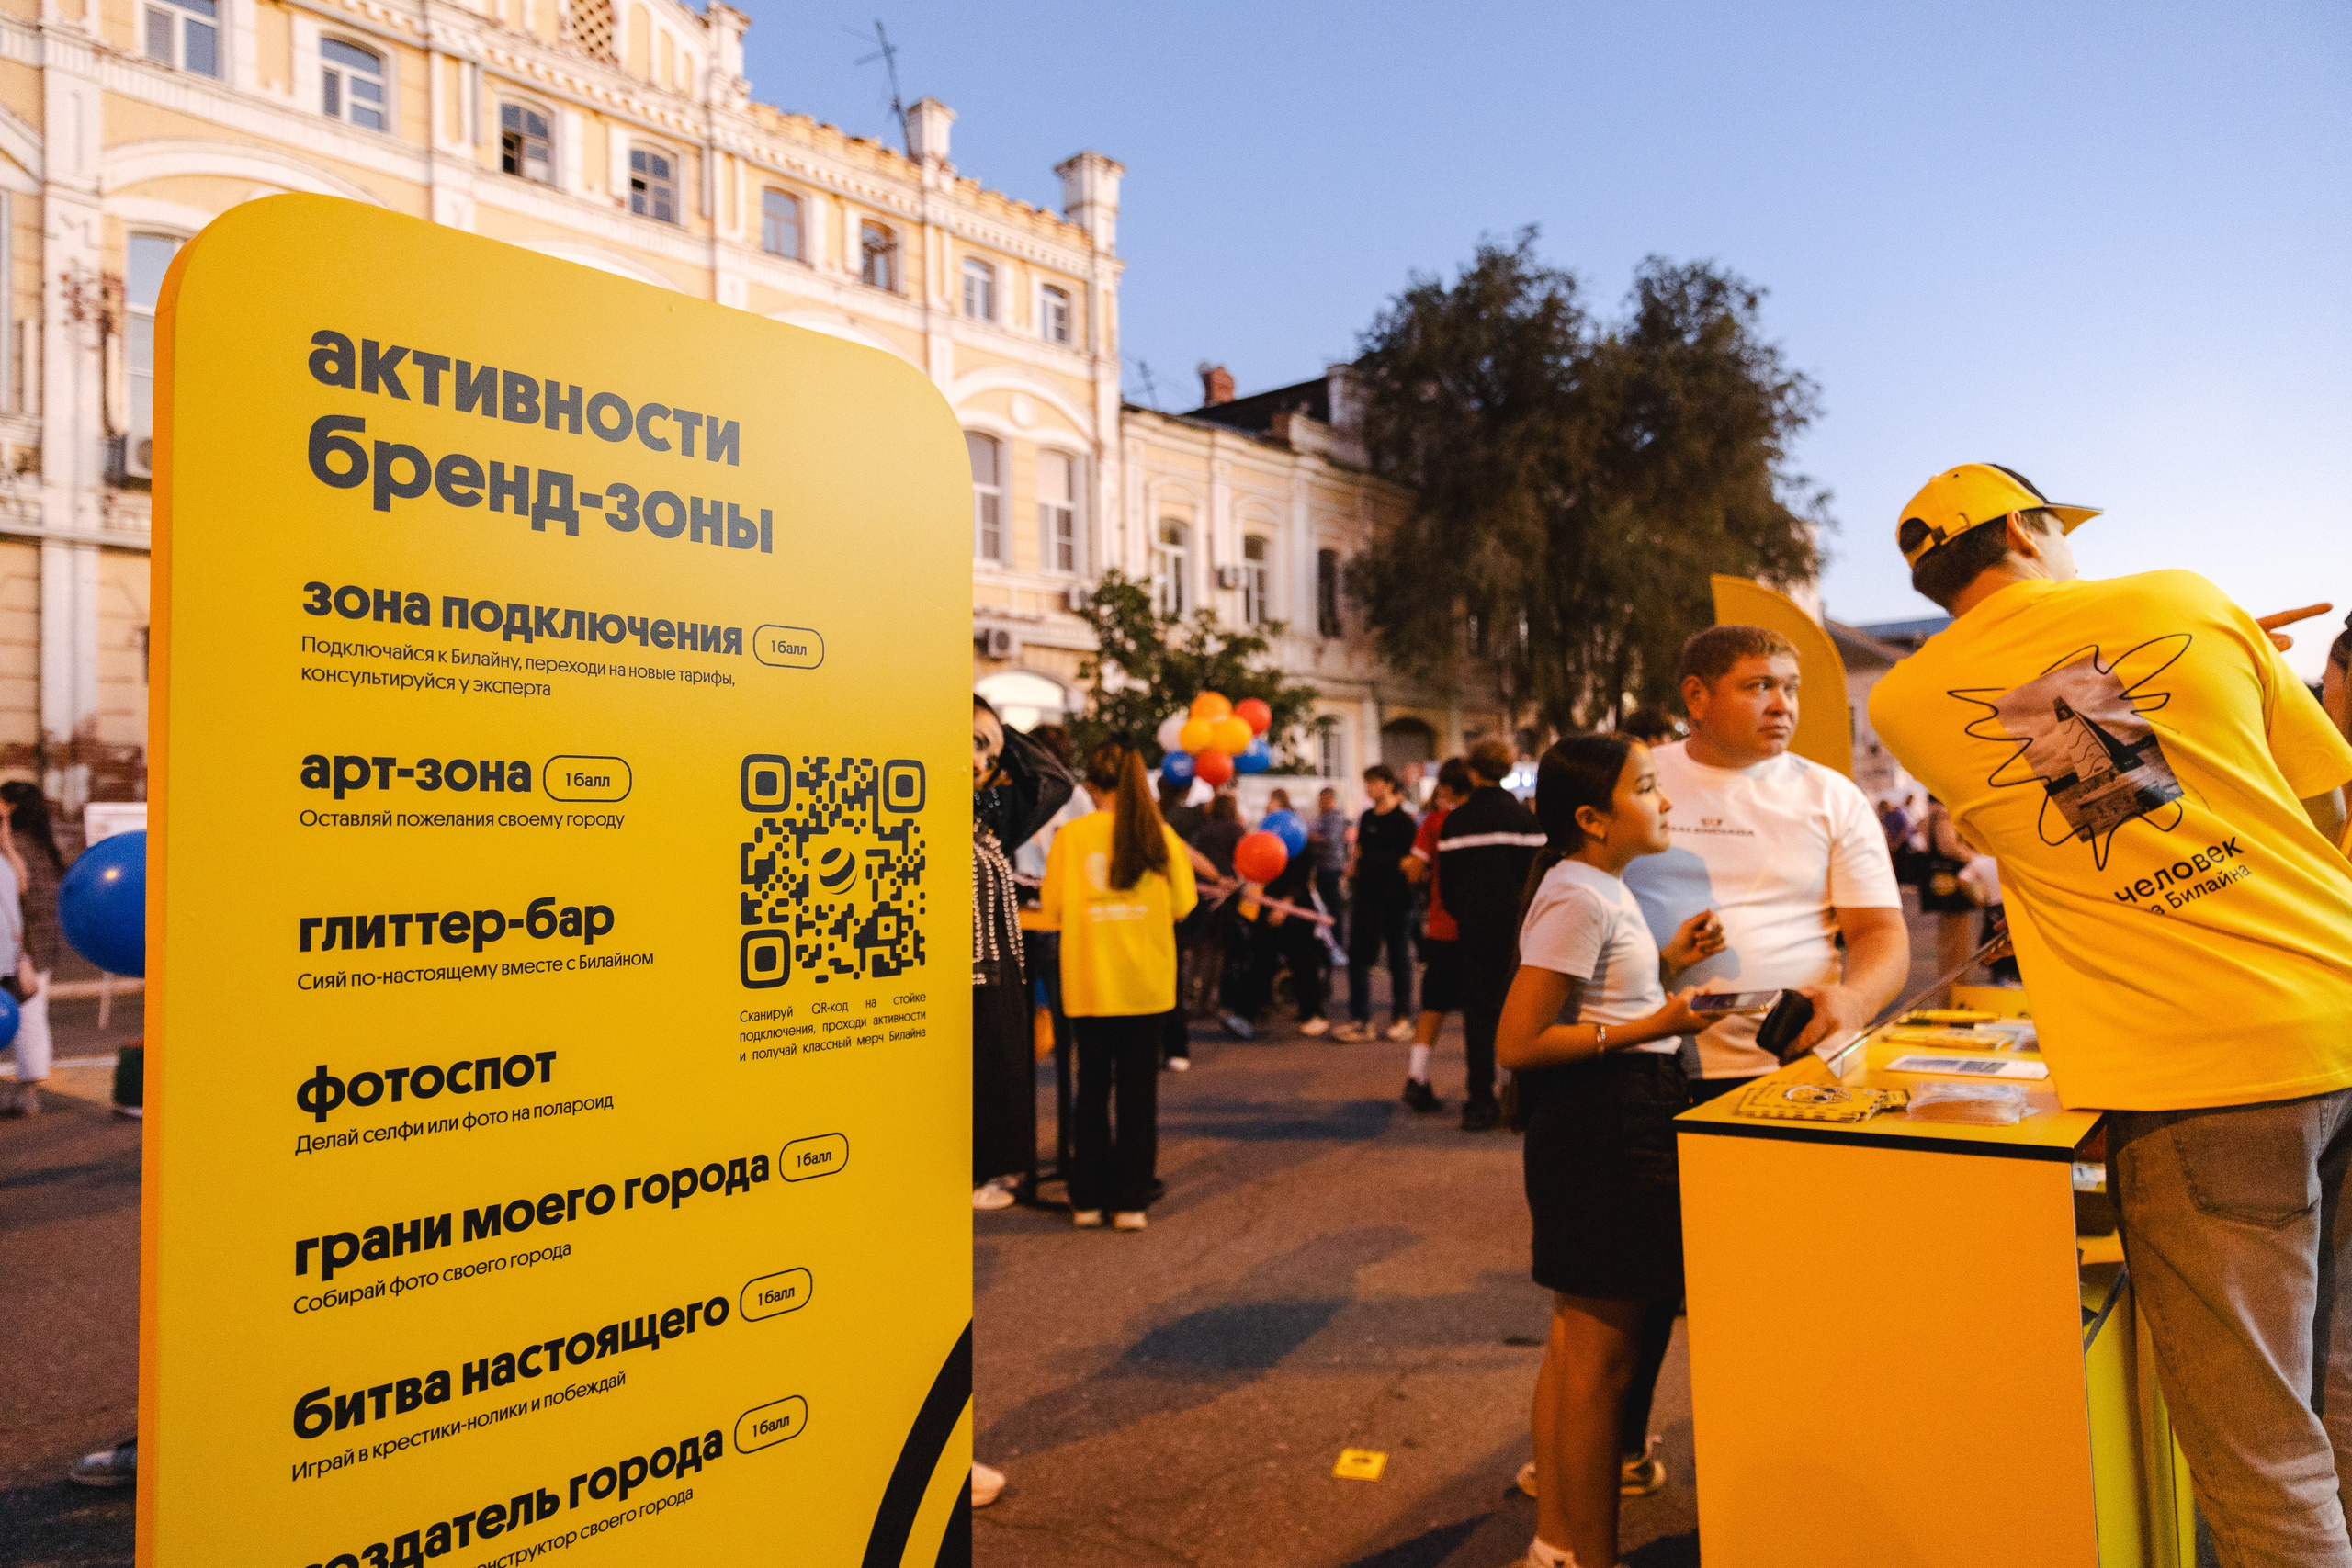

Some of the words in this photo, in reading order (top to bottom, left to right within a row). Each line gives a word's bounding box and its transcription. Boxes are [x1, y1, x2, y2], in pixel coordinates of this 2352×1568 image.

[308, 329, 740, 467] активности
[307, 413, 773, 554] бренд-зоны
[302, 581, 431, 626] зона
[441, 595, 743, 656] подключения
[301, 635, 435, 662] Подключайся
[437, 650, 448, 664] к
[451, 648, 523, 672] Билайну,
[526, 657, 606, 678] переходи
[609, 664, 626, 677] на
[628, 666, 676, 681] новые
[678, 669, 736, 687] тарифы,
[301, 667, 456, 692] консультируйся
[458, 678, 470, 694] у
[472, 679, 551, 699] эксперта
[300, 753, 532, 801] арт-зона
[299, 808, 393, 828] Оставляй
[396, 813, 494, 827] пожелания
[497, 814, 564, 830] своему
[566, 814, 626, 830] городу
[2114, 837, 2245, 903] человек
[2165, 864, 2252, 909] Билайна
[299, 896, 616, 953] глиттер-бар
[297, 970, 347, 991] Сияй
[351, 964, 499, 987] по-настоящему
[501, 959, 564, 976] вместе
[565, 958, 576, 971] с
[579, 952, 654, 970] Билайном
[739, 1005, 794, 1023] Сканируй
[811, 1001, 849, 1015] QR-код
[865, 998, 877, 1009] на
[892, 992, 927, 1006] стойке
[739, 1024, 816, 1043] подключения,
[822, 1018, 867, 1034] проходи
[872, 1010, 926, 1026] активности
[739, 1052, 747, 1063] и
[752, 1043, 797, 1061] получай
[802, 1035, 852, 1054] классный
[856, 1033, 885, 1046] мерч
[888, 1027, 926, 1042] Билайна
[296, 1050, 558, 1124] фотоспот
[294, 1127, 359, 1157] Делай
[362, 1120, 424, 1144] селфи
[427, 1117, 459, 1134] или
[461, 1111, 509, 1133] фото
[511, 1107, 530, 1122] на
[533, 1095, 615, 1119] полароид
[295, 1212, 452, 1282] грани
[462, 1183, 616, 1244] моего
[624, 1154, 770, 1211] города
[293, 1279, 386, 1314] Собирай
[389, 1271, 440, 1297] фото
[442, 1258, 507, 1282] своего
[510, 1243, 571, 1269] города
[292, 1369, 451, 1440] битва
[461, 1295, 730, 1397] настоящего
[291, 1448, 355, 1483] Играй
[358, 1448, 369, 1463] в
[372, 1401, 528, 1460] крестики-нолики
[530, 1397, 541, 1413] и
[543, 1370, 626, 1409] побеждай
[304, 1486, 560, 1568] здатель
[569, 1428, 724, 1511] города
[474, 1530, 578, 1568] нструктор
[579, 1508, 638, 1540] своего
[639, 1488, 694, 1518] города
